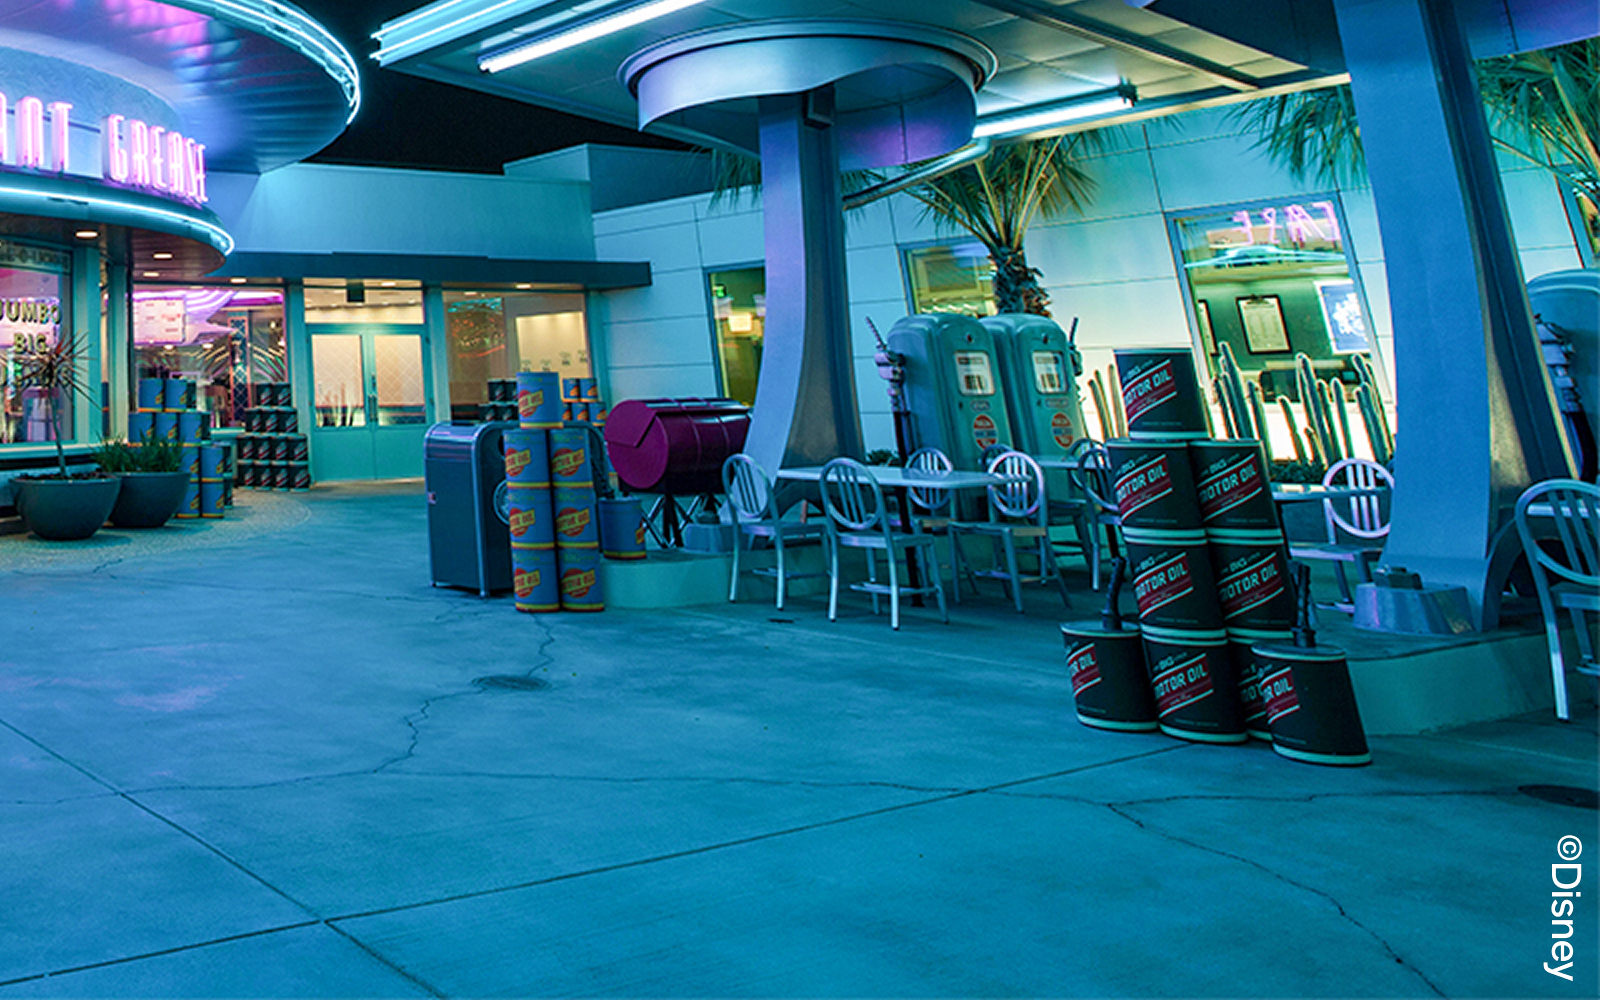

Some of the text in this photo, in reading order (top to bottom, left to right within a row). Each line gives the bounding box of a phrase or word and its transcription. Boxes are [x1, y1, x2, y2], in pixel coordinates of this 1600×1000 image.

[106, 113, 210, 204] GREASE
[13, 334, 48, 354] BIG
[1153, 369, 1172, 388] OIL
[1148, 464, 1167, 482] OIL
[1240, 464, 1257, 482] OIL
[1167, 563, 1188, 581] OIL
[1261, 563, 1278, 581] OIL
[1188, 664, 1208, 683] OIL
